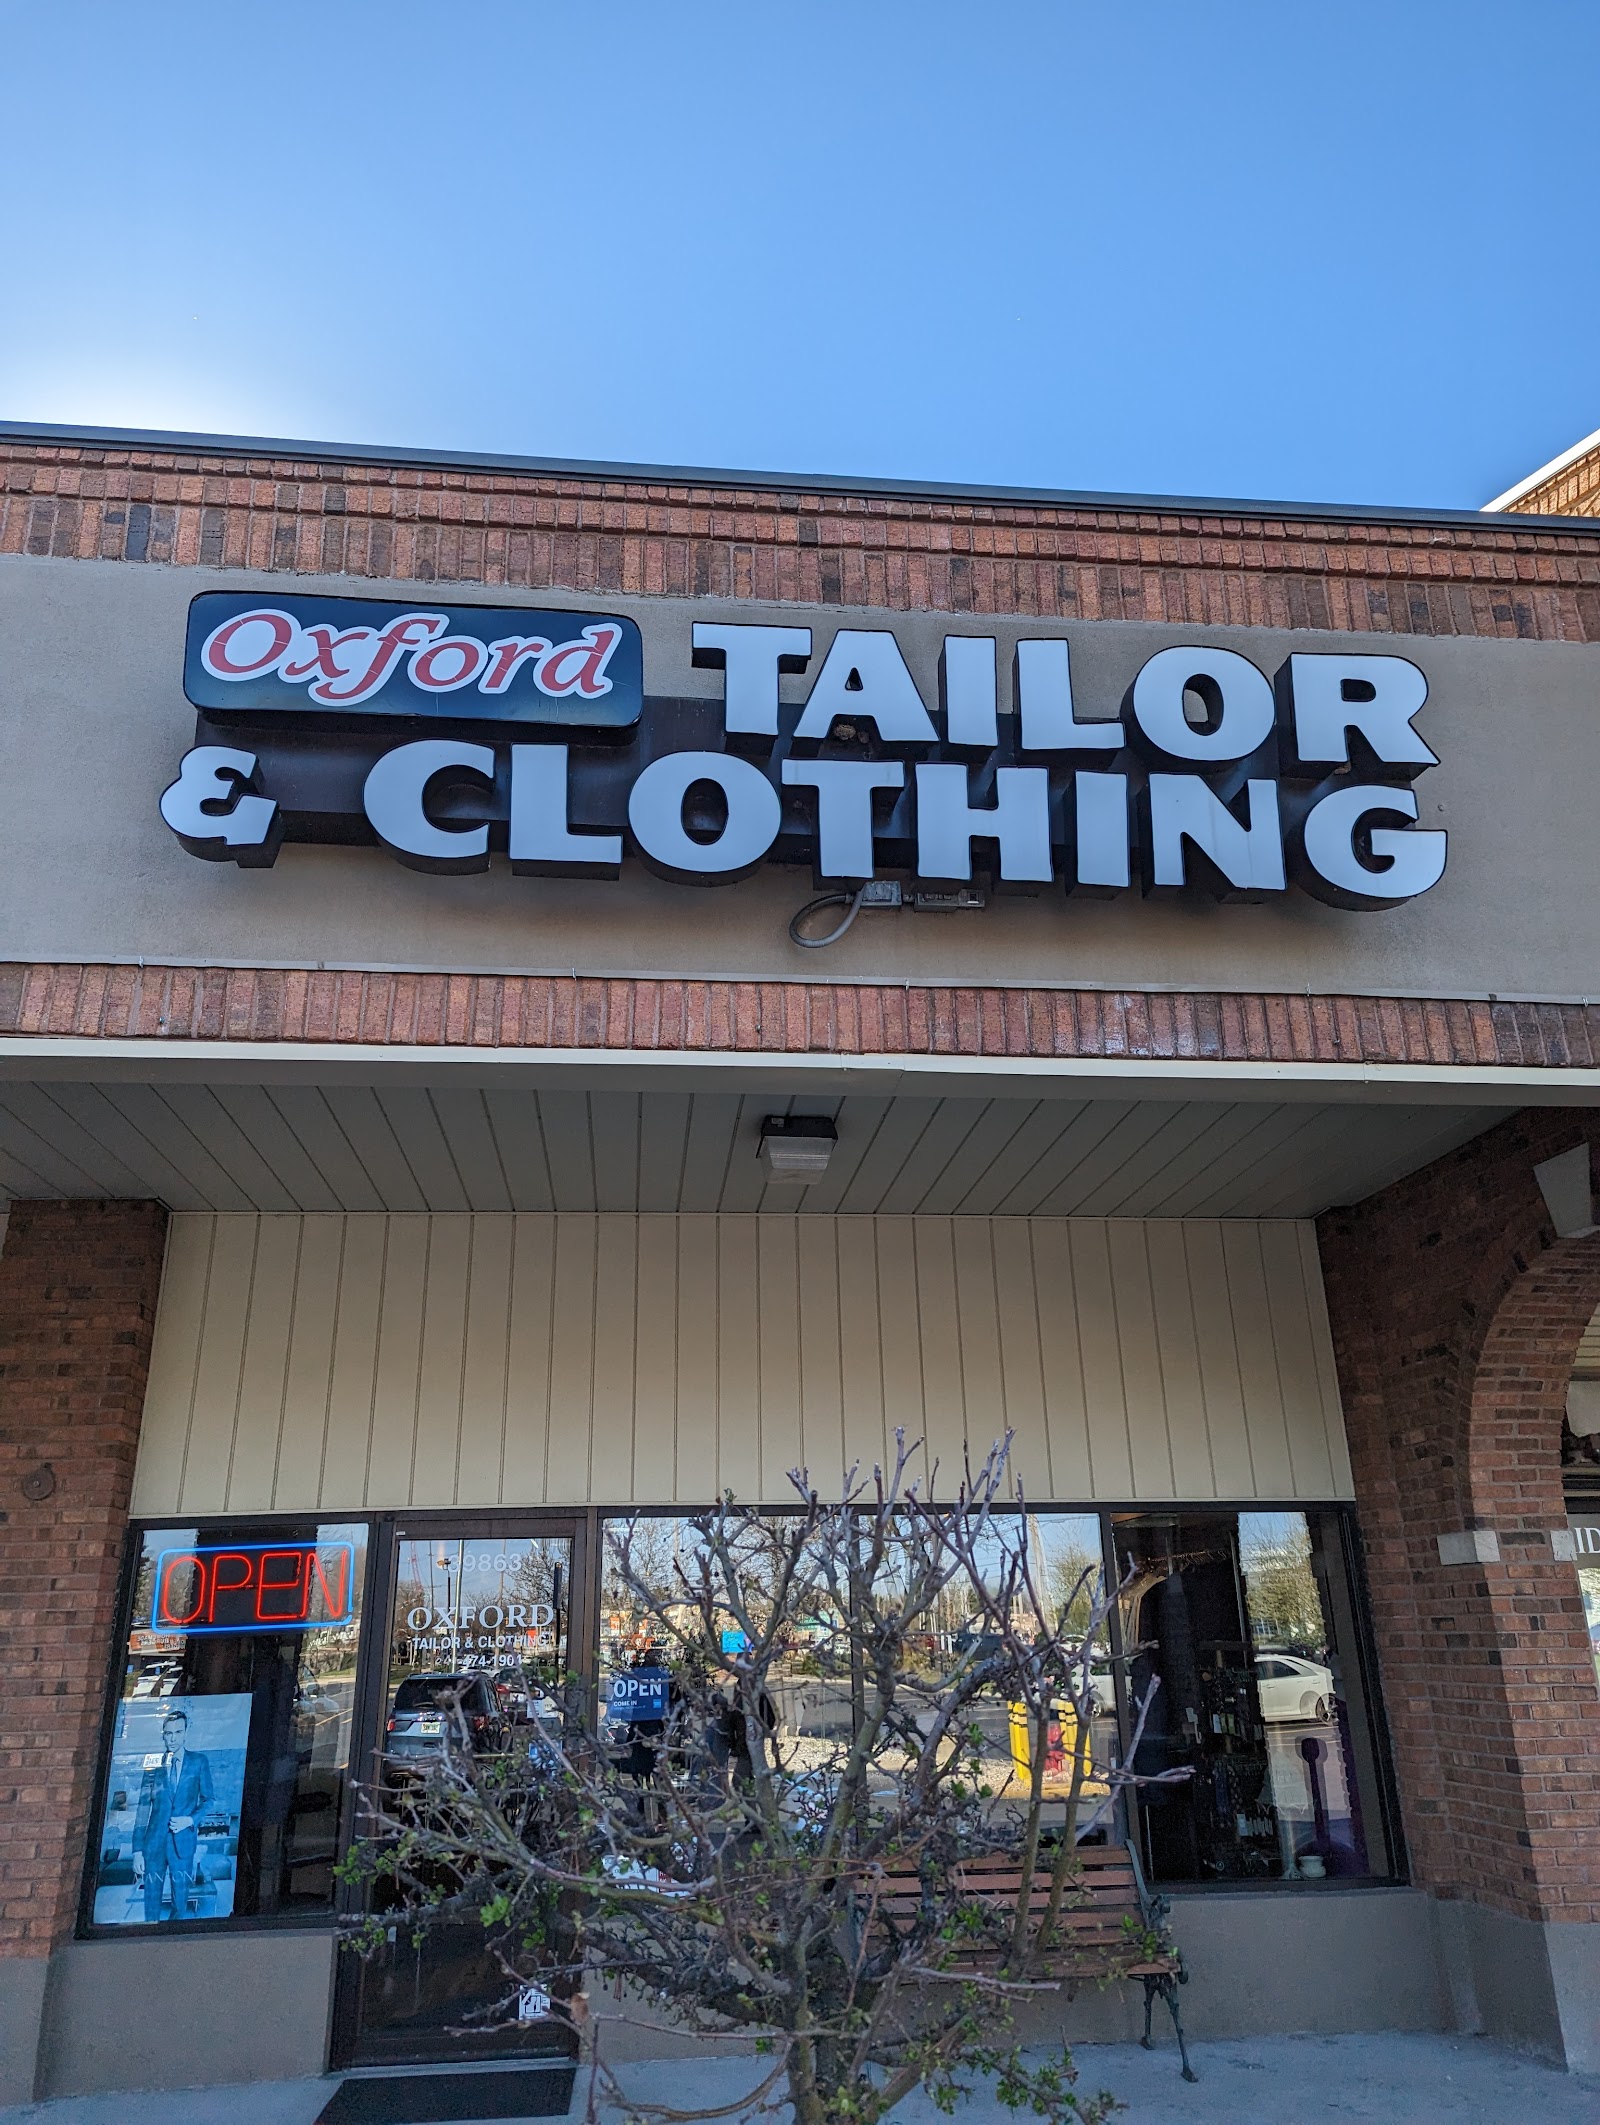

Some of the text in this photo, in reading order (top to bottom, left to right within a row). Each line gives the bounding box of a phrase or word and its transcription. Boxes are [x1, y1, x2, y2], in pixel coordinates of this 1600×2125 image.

[203, 610, 621, 705] Oxford
[692, 621, 1441, 766] TAILOR
[160, 738, 1448, 899] & CLOTHING
[163, 1550, 348, 1624] OPEN
[449, 1553, 522, 1573] 39863
[407, 1604, 554, 1631] OXFORD
[412, 1634, 547, 1650] TAILOR & CLOTHING
[613, 1678, 662, 1698] OPEN
